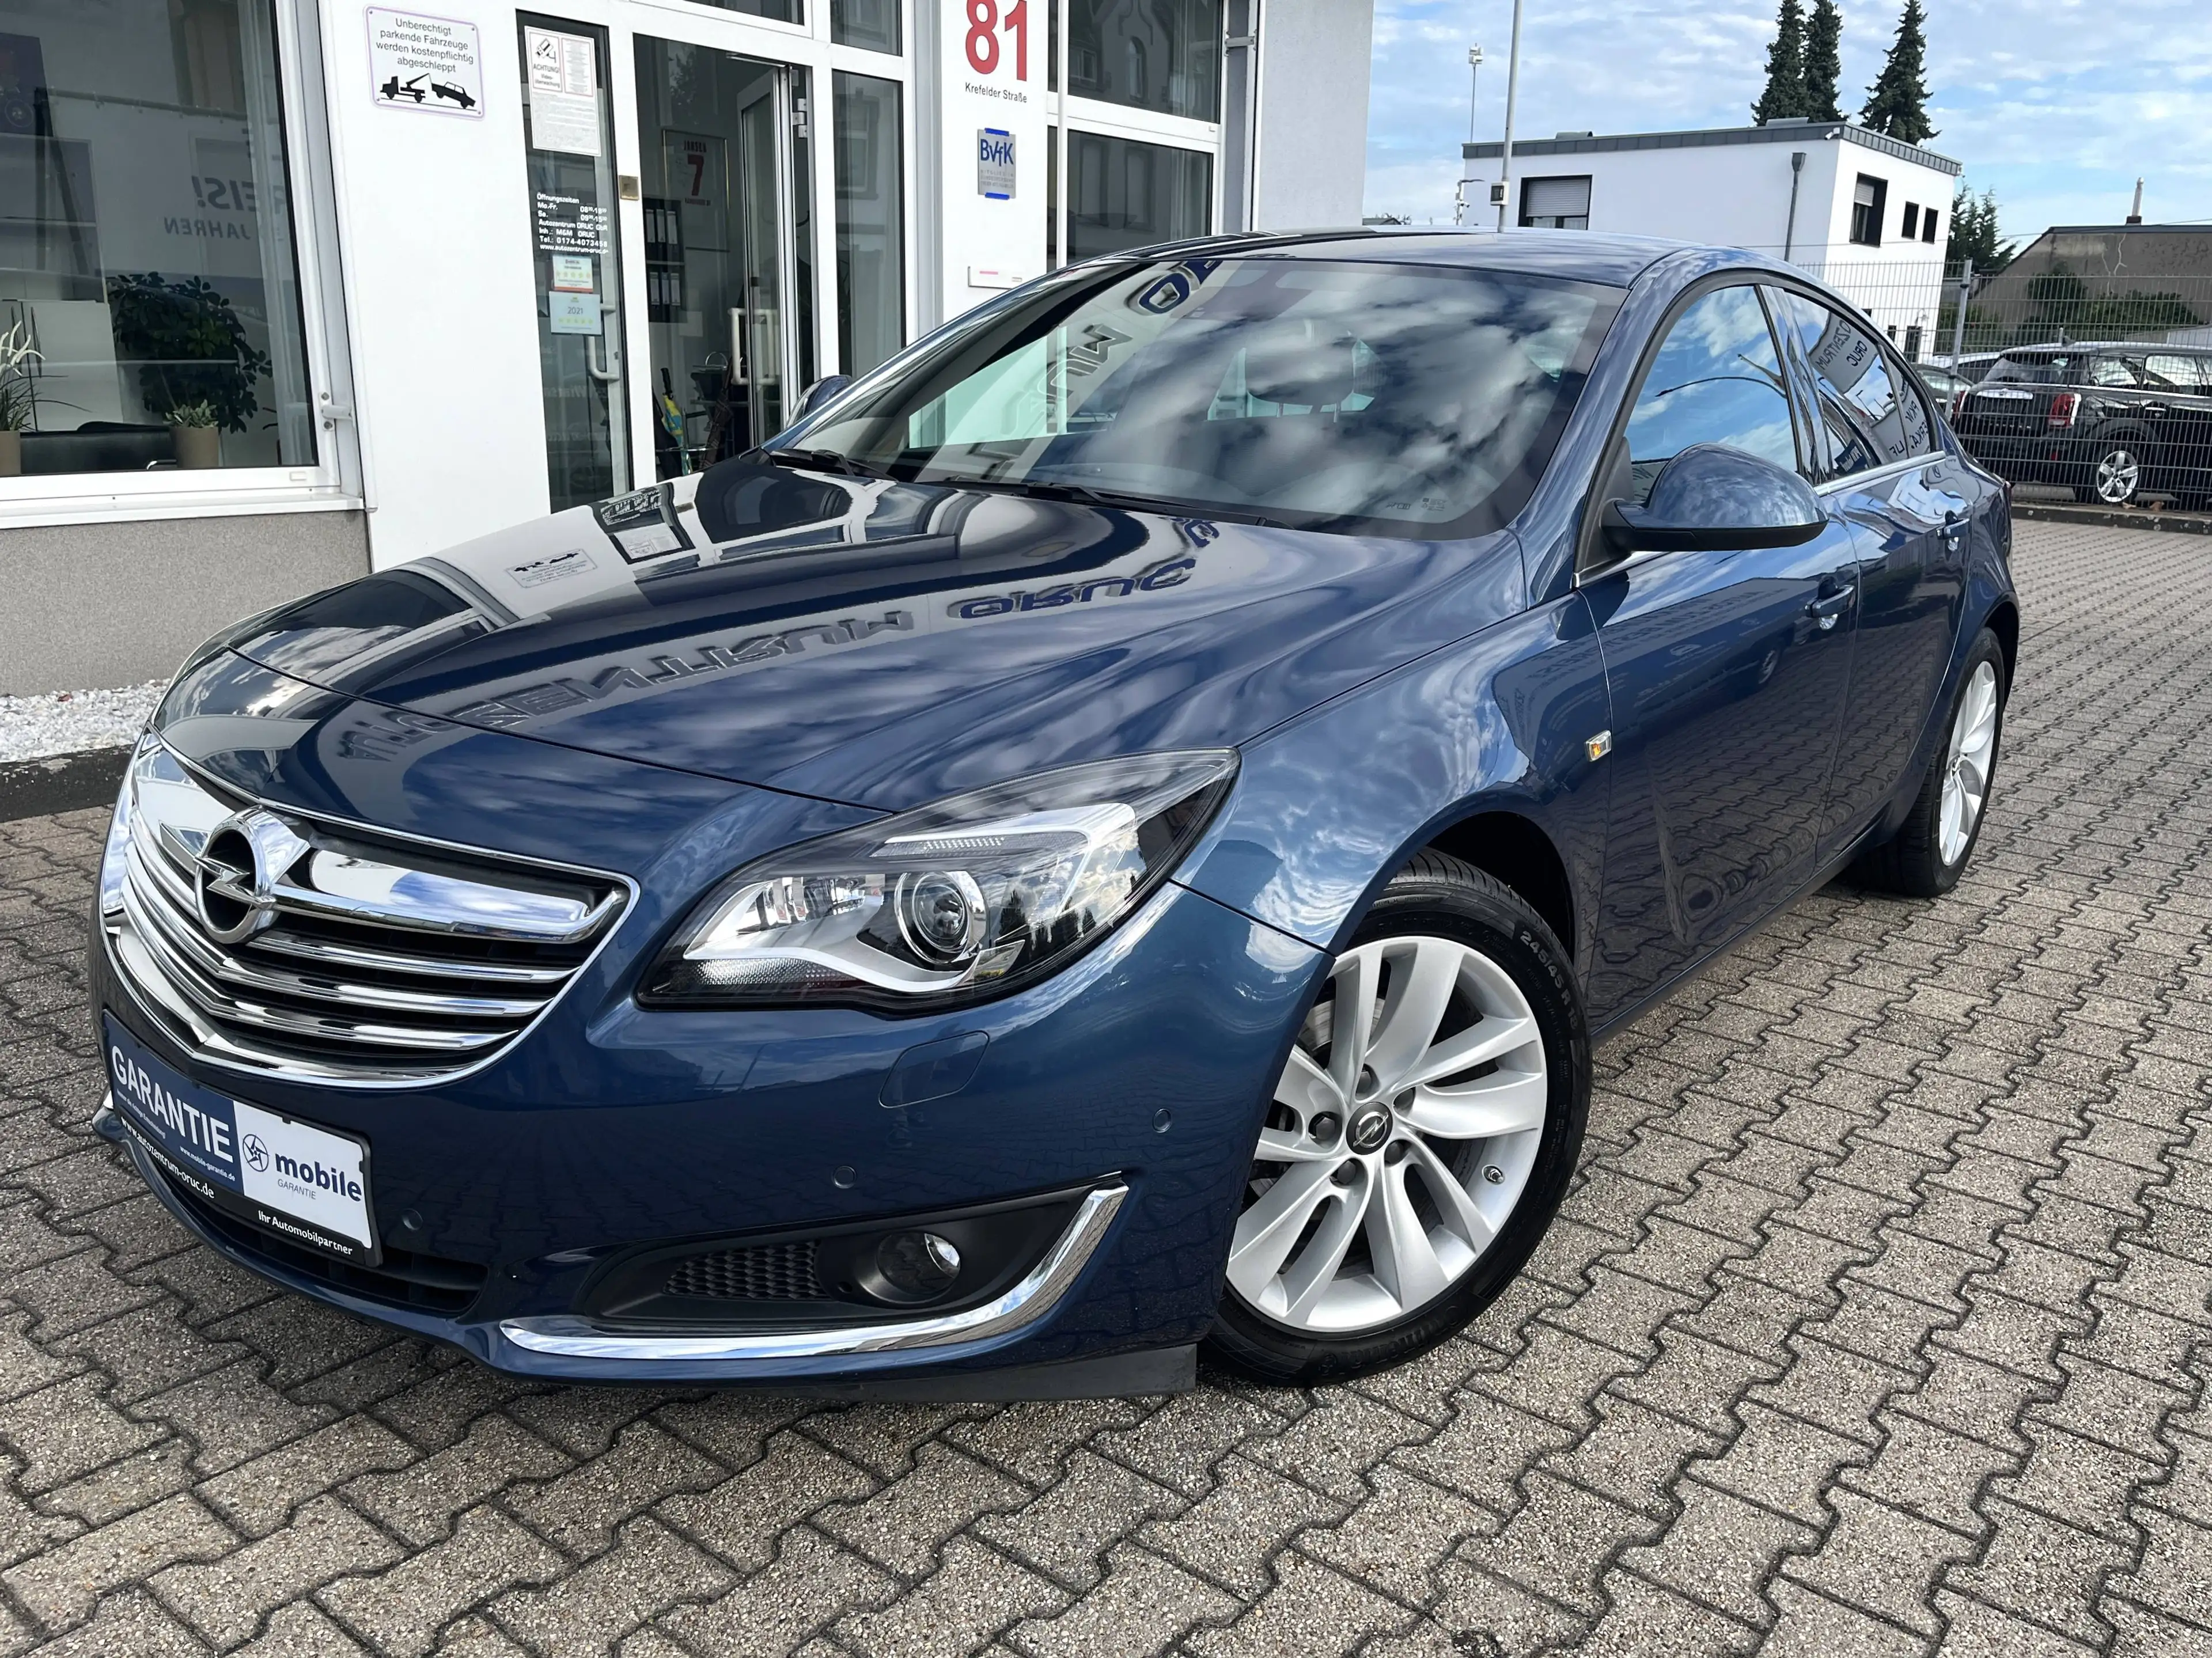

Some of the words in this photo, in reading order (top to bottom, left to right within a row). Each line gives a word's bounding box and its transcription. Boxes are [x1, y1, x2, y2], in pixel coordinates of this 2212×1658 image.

[395, 18, 452, 36] Unberechtigt
[380, 30, 421, 43] parkende
[424, 35, 468, 51] Fahrzeuge
[965, 0, 1027, 82] 81
[376, 41, 409, 53] werden
[411, 45, 474, 65] kostenpflichtig
[397, 57, 456, 73] abgeschleppt
[965, 82, 1001, 98] Krefelder
[1003, 90, 1027, 103] Straße
[687, 153, 704, 196] 7
[537, 192, 579, 204] Öffnungszeiten
[539, 219, 576, 229] Autozentrum
[577, 222, 594, 230] ORUC
[567, 306, 584, 314] 2021
[1520, 930, 1565, 989] 245/45
[1561, 989, 1571, 1006] R
[112, 1045, 233, 1163] GARANTIE
[120, 1116, 215, 1199] www.autozentrum-oruc.de
[275, 1154, 362, 1202] mobile
[278, 1178, 316, 1200] GARANTIE
[258, 1210, 271, 1224] Ihr
[272, 1216, 353, 1255] Automobilpartner
